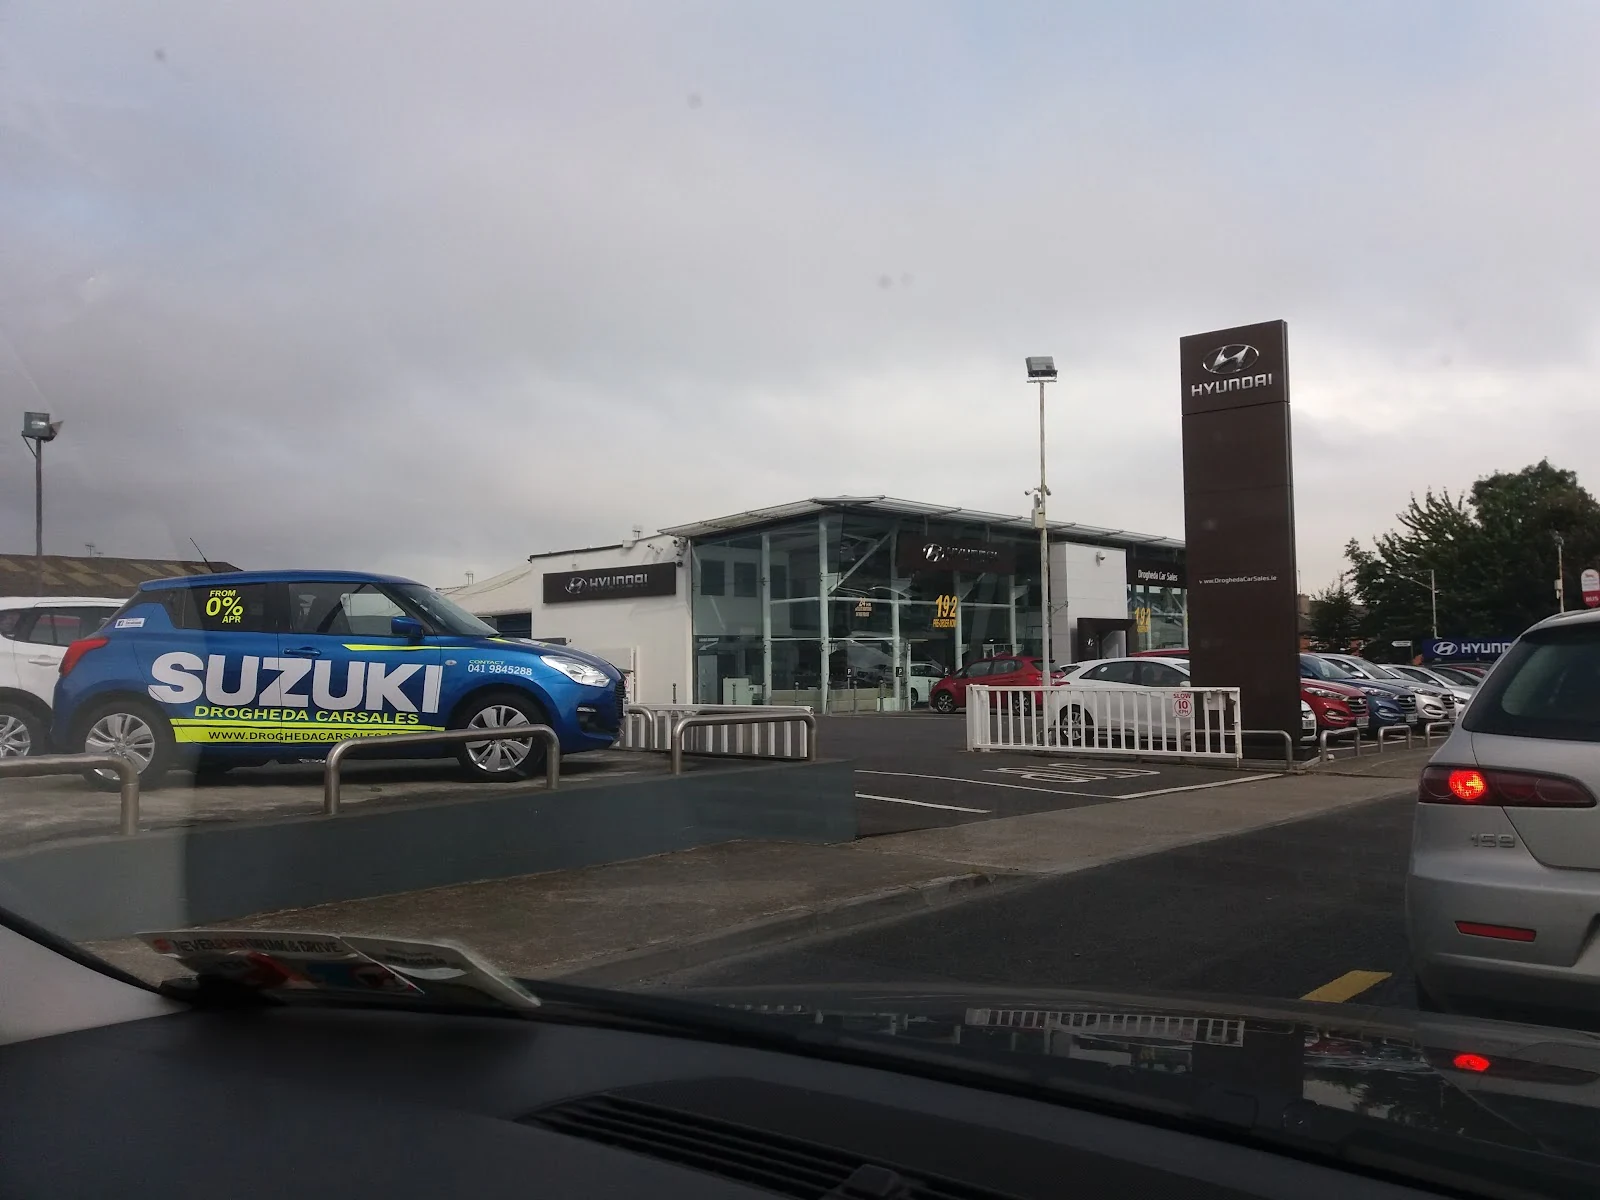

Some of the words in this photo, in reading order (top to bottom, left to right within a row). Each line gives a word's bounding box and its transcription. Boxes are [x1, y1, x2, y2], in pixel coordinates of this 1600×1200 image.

[1191, 373, 1273, 397] HYUNDAI
[590, 573, 648, 590] HYUNDAI
[1137, 569, 1158, 581] Drogheda
[1159, 571, 1167, 580] Car
[1166, 572, 1178, 582] Sales
[209, 589, 237, 597] FROM
[206, 596, 243, 616] 0%
[935, 594, 958, 618] 192
[221, 615, 241, 624] APR
[467, 664, 486, 673] 041
[488, 664, 533, 676] 9845288
[148, 651, 443, 714] SUZUKI
[1178, 700, 1188, 709] 10
[194, 705, 309, 722] DROGHEDA
[315, 710, 420, 725] CARSALES
[208, 731, 398, 742] WWW.DROGHEDACARSA
[1471, 833, 1515, 848] 159
